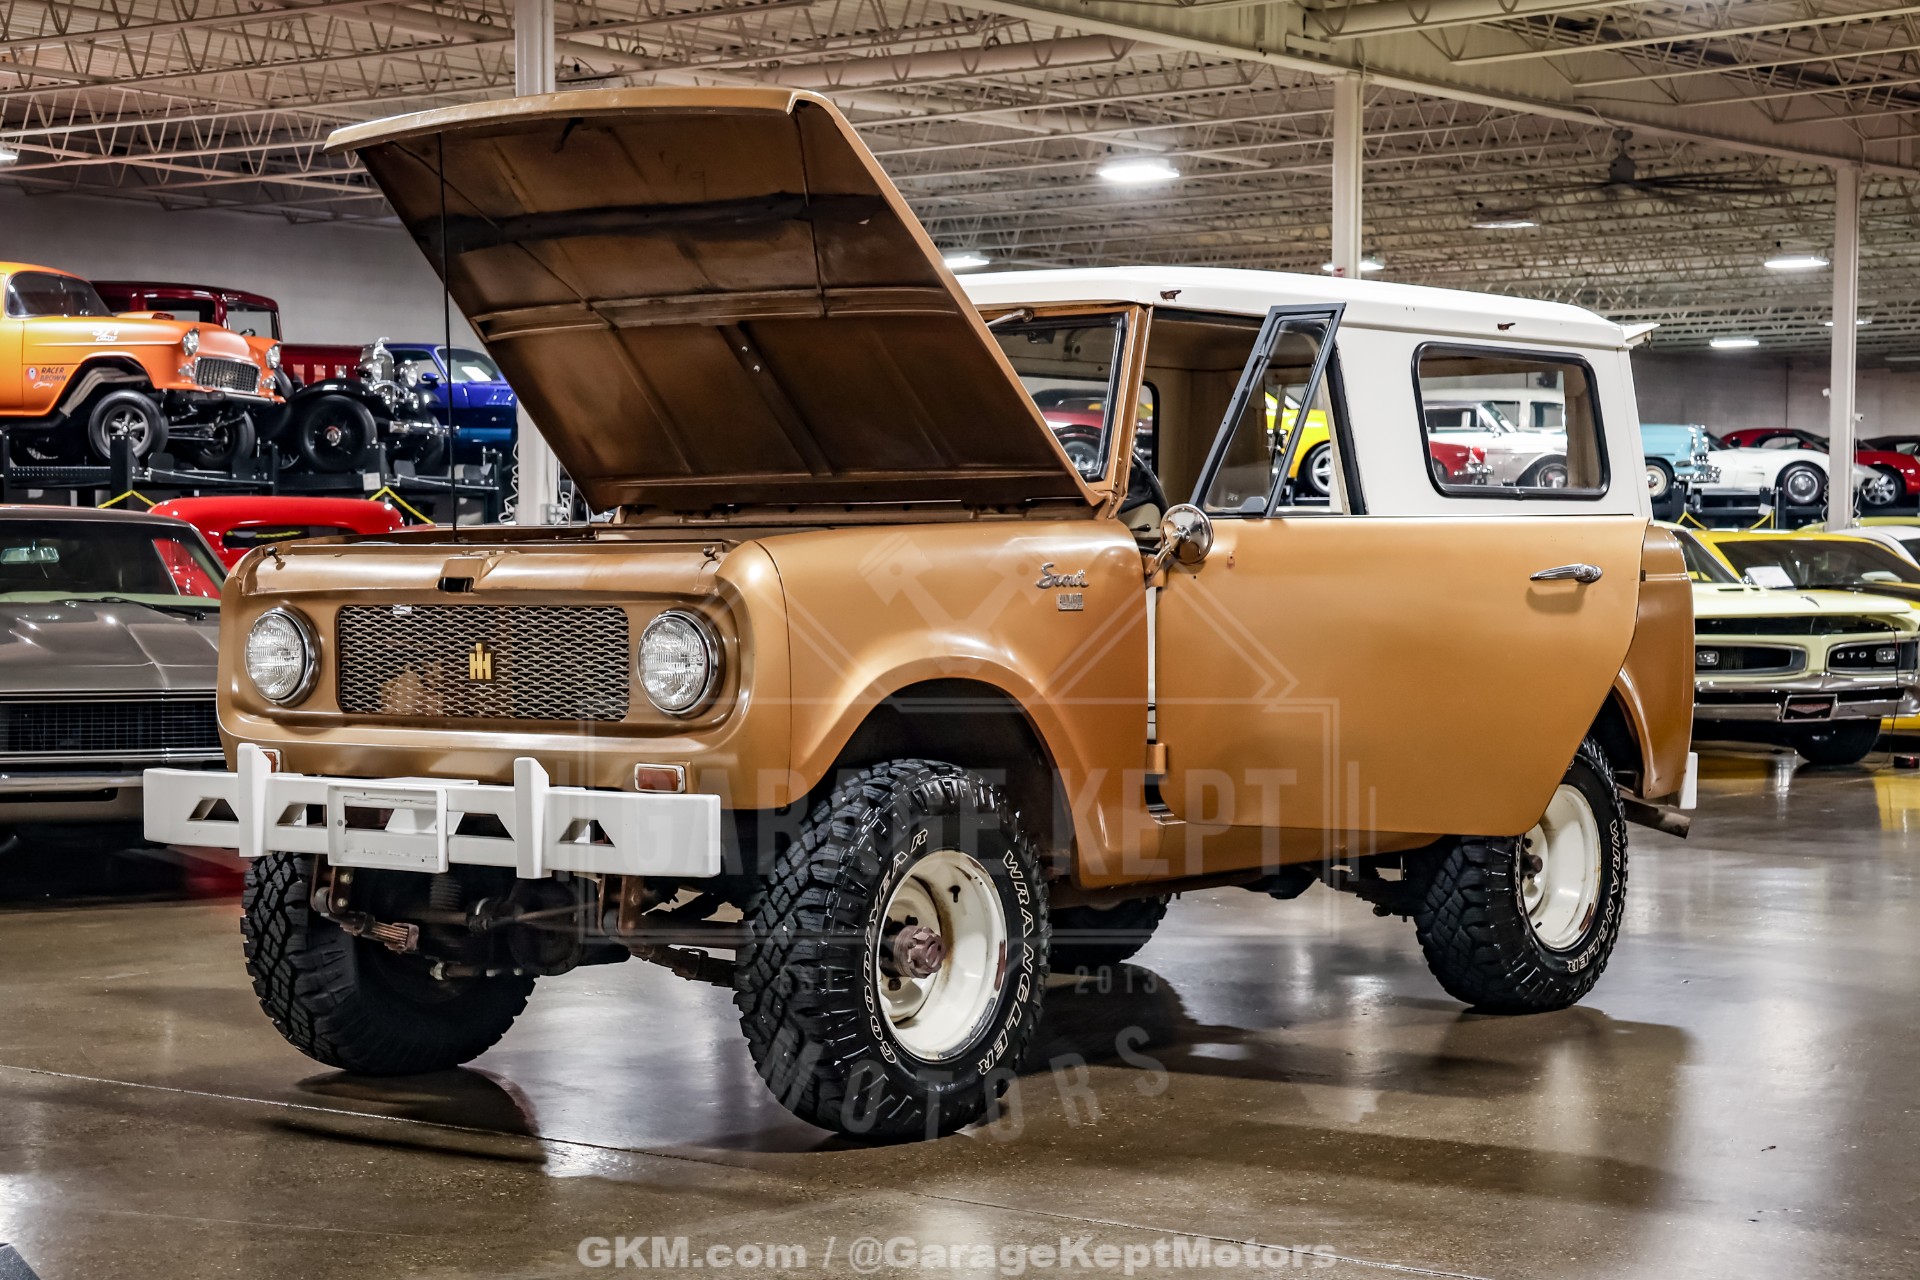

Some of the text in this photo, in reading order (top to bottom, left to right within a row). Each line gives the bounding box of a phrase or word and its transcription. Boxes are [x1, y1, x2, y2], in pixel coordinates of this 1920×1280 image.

[1836, 651, 1867, 660] GTO
[863, 828, 929, 1064] GOODYEAR
[977, 850, 1035, 1076] WRANGLER
[1567, 818, 1621, 974] WRANGLER
